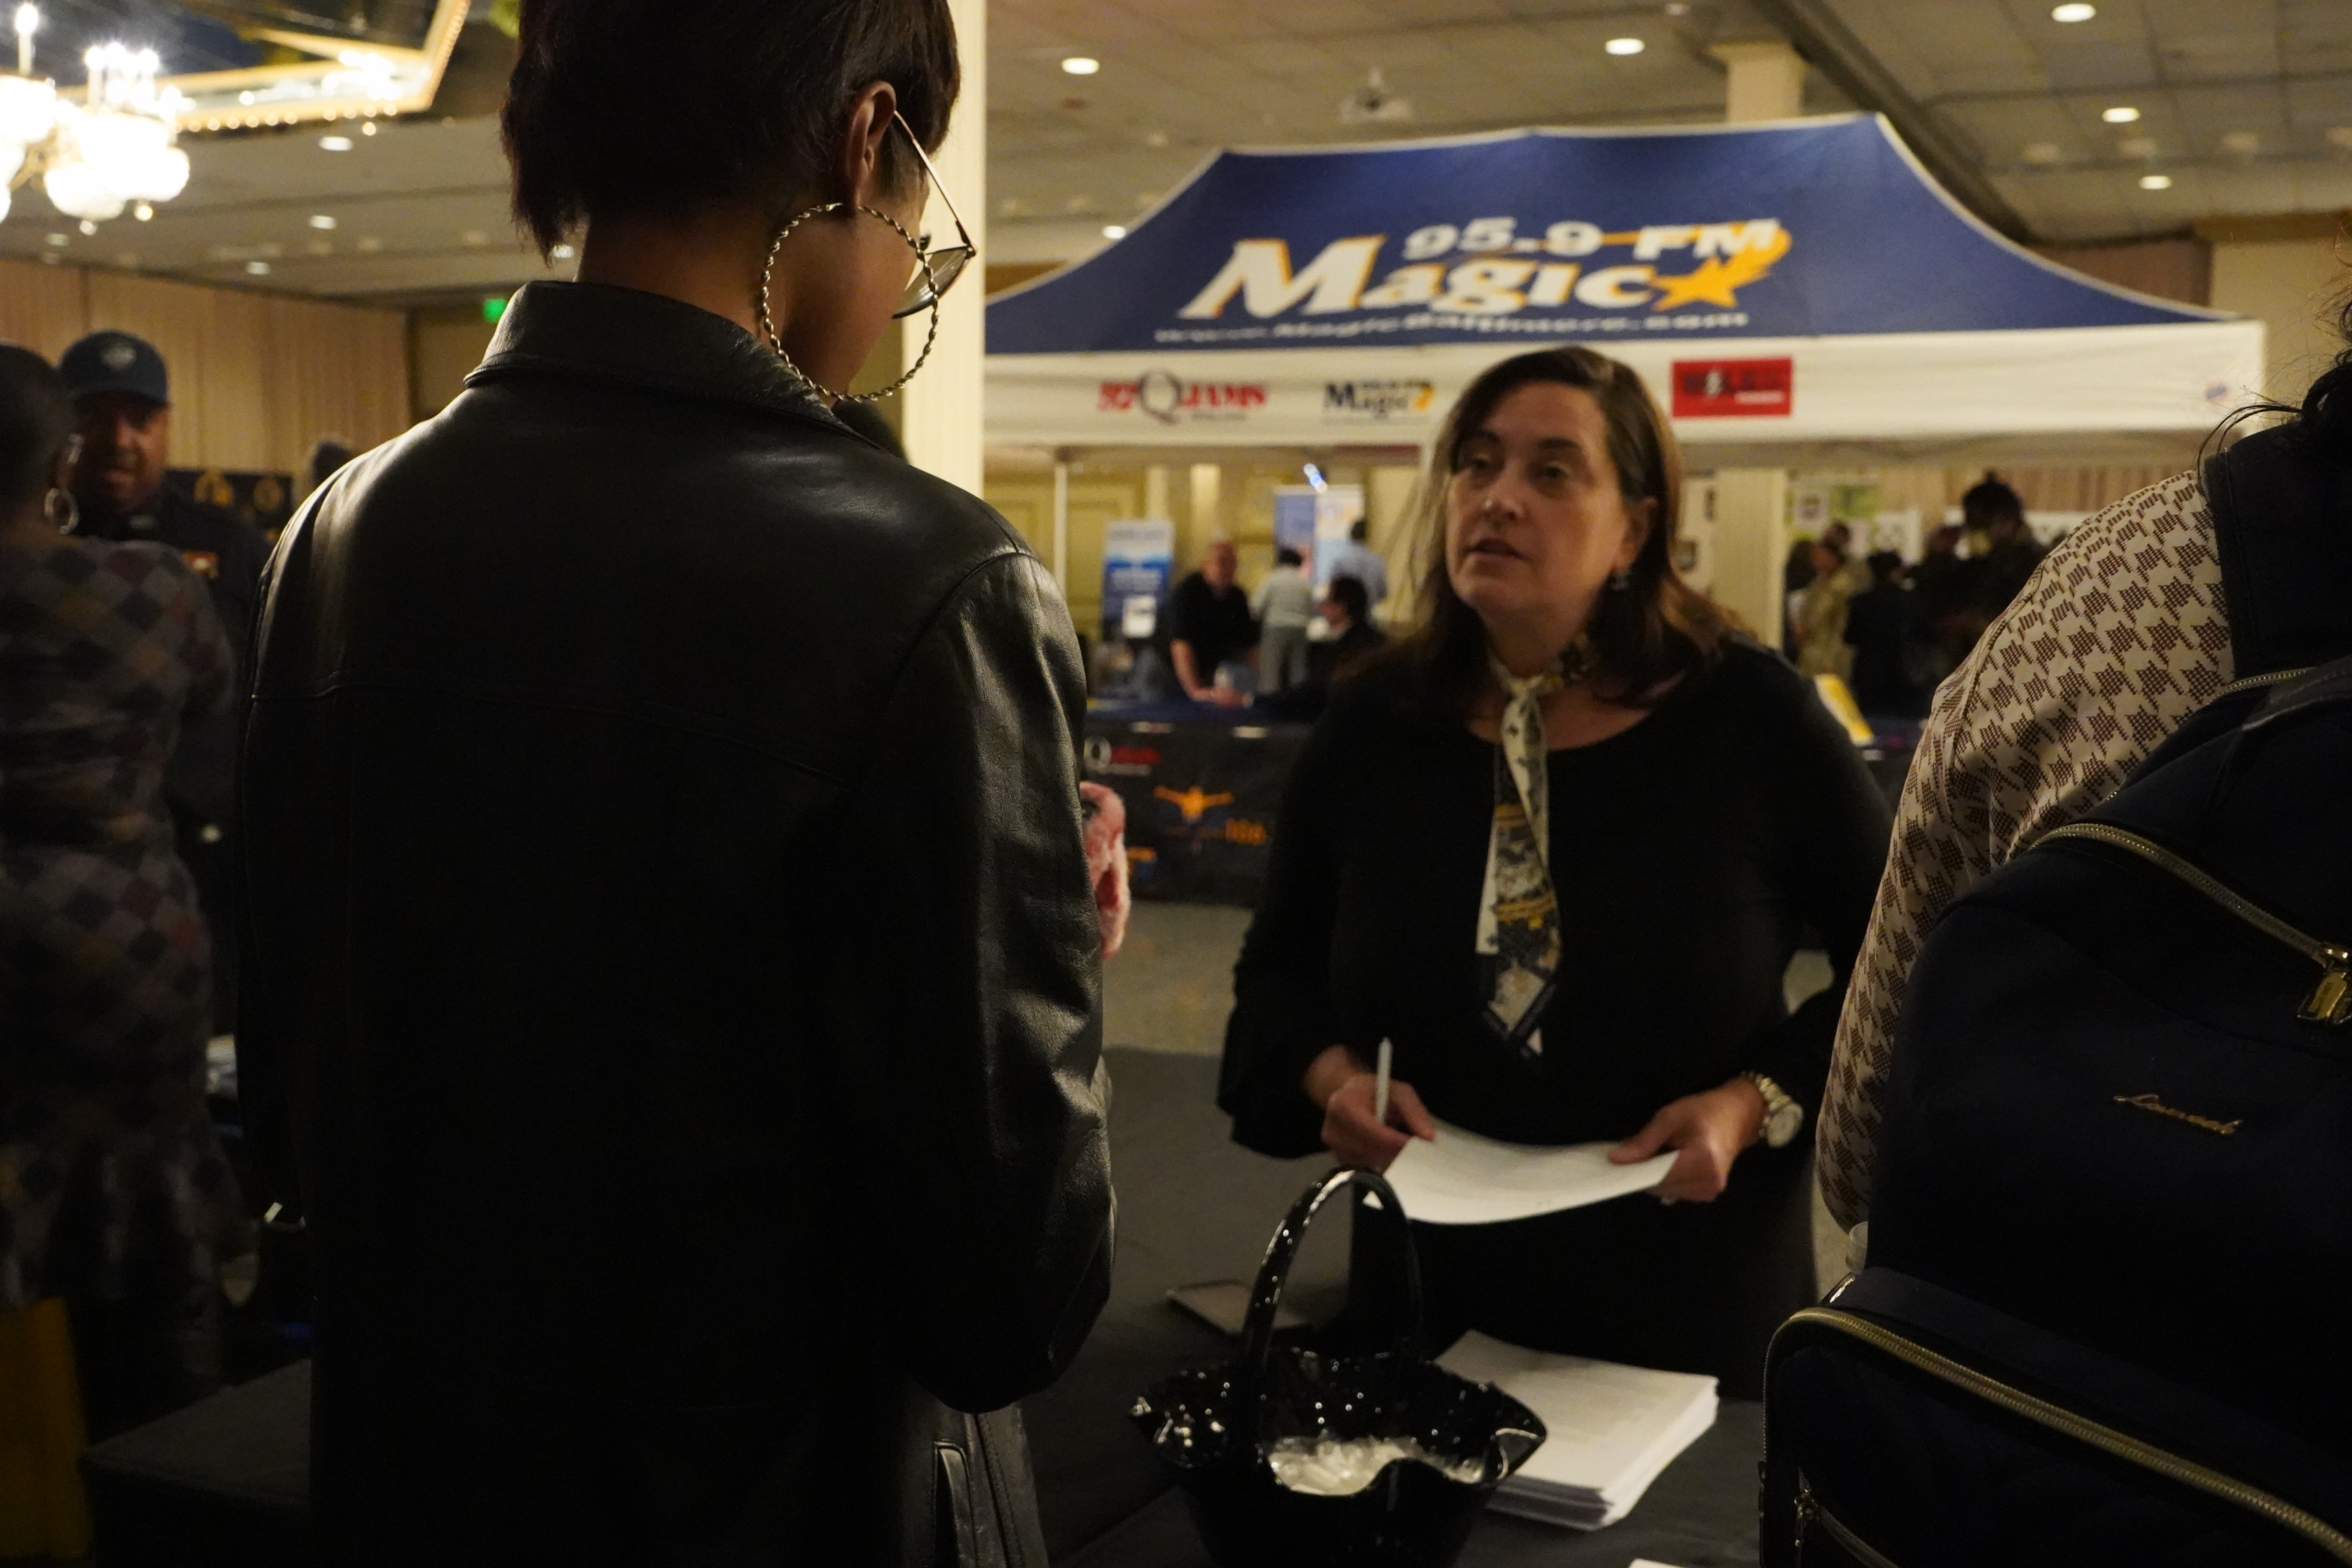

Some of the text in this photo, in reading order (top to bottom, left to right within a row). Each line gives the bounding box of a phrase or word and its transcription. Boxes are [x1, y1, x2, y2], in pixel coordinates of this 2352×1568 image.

[1401, 216, 1781, 260] 95.9 FM
[1177, 234, 1654, 318] Magic
